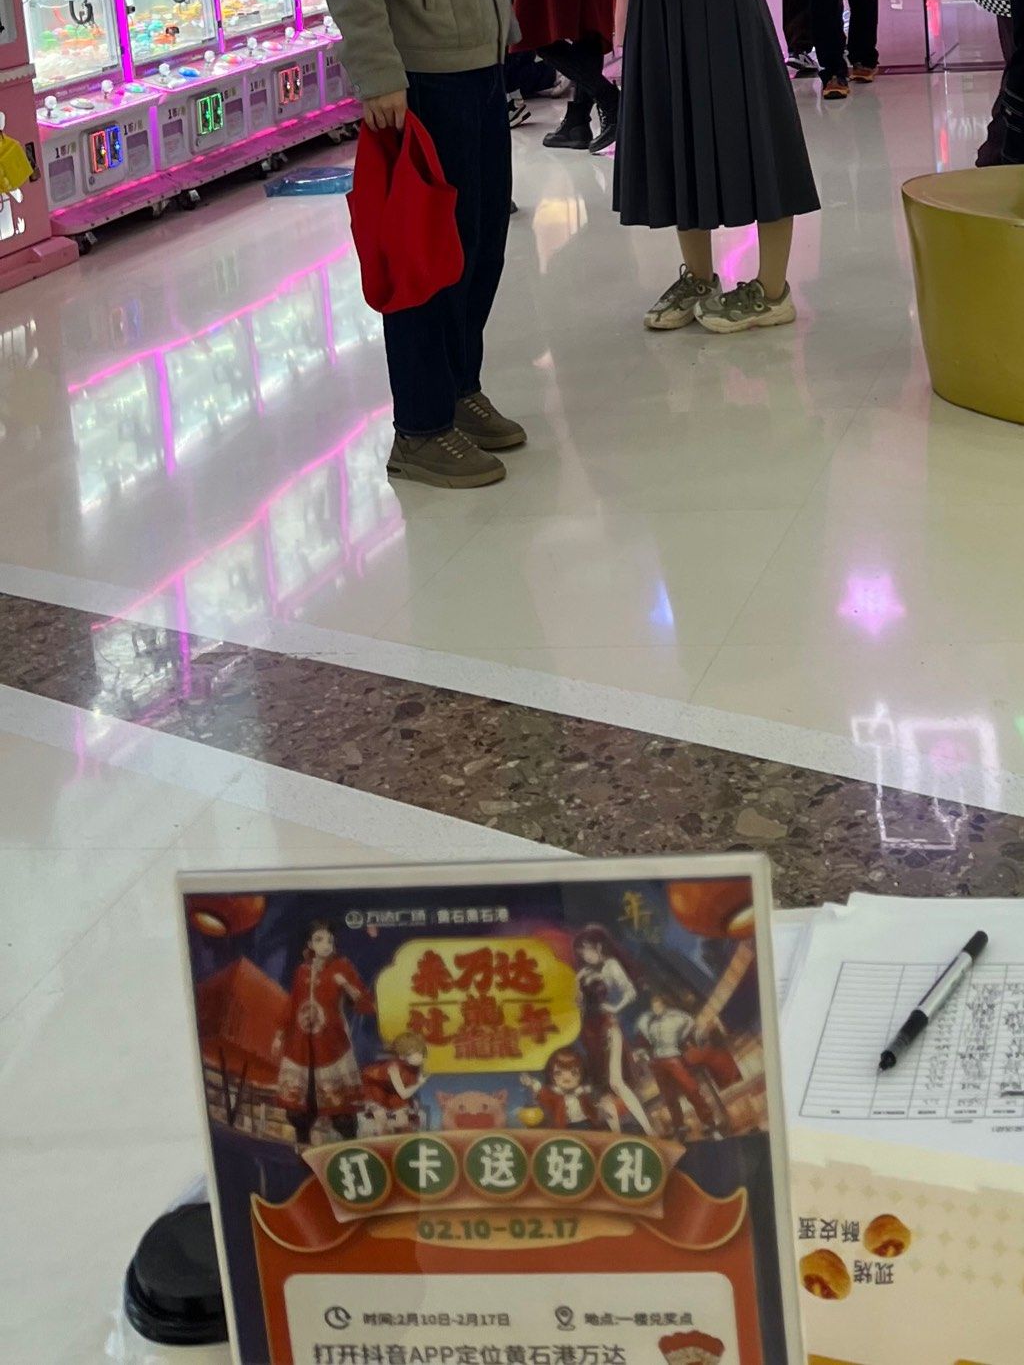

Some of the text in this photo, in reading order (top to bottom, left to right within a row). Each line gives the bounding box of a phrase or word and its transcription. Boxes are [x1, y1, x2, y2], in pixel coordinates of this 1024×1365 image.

[338, 1142, 652, 1200] 打卡送好礼
[417, 1217, 580, 1242] 02.10-02.17
[853, 1260, 894, 1285] 现烤
